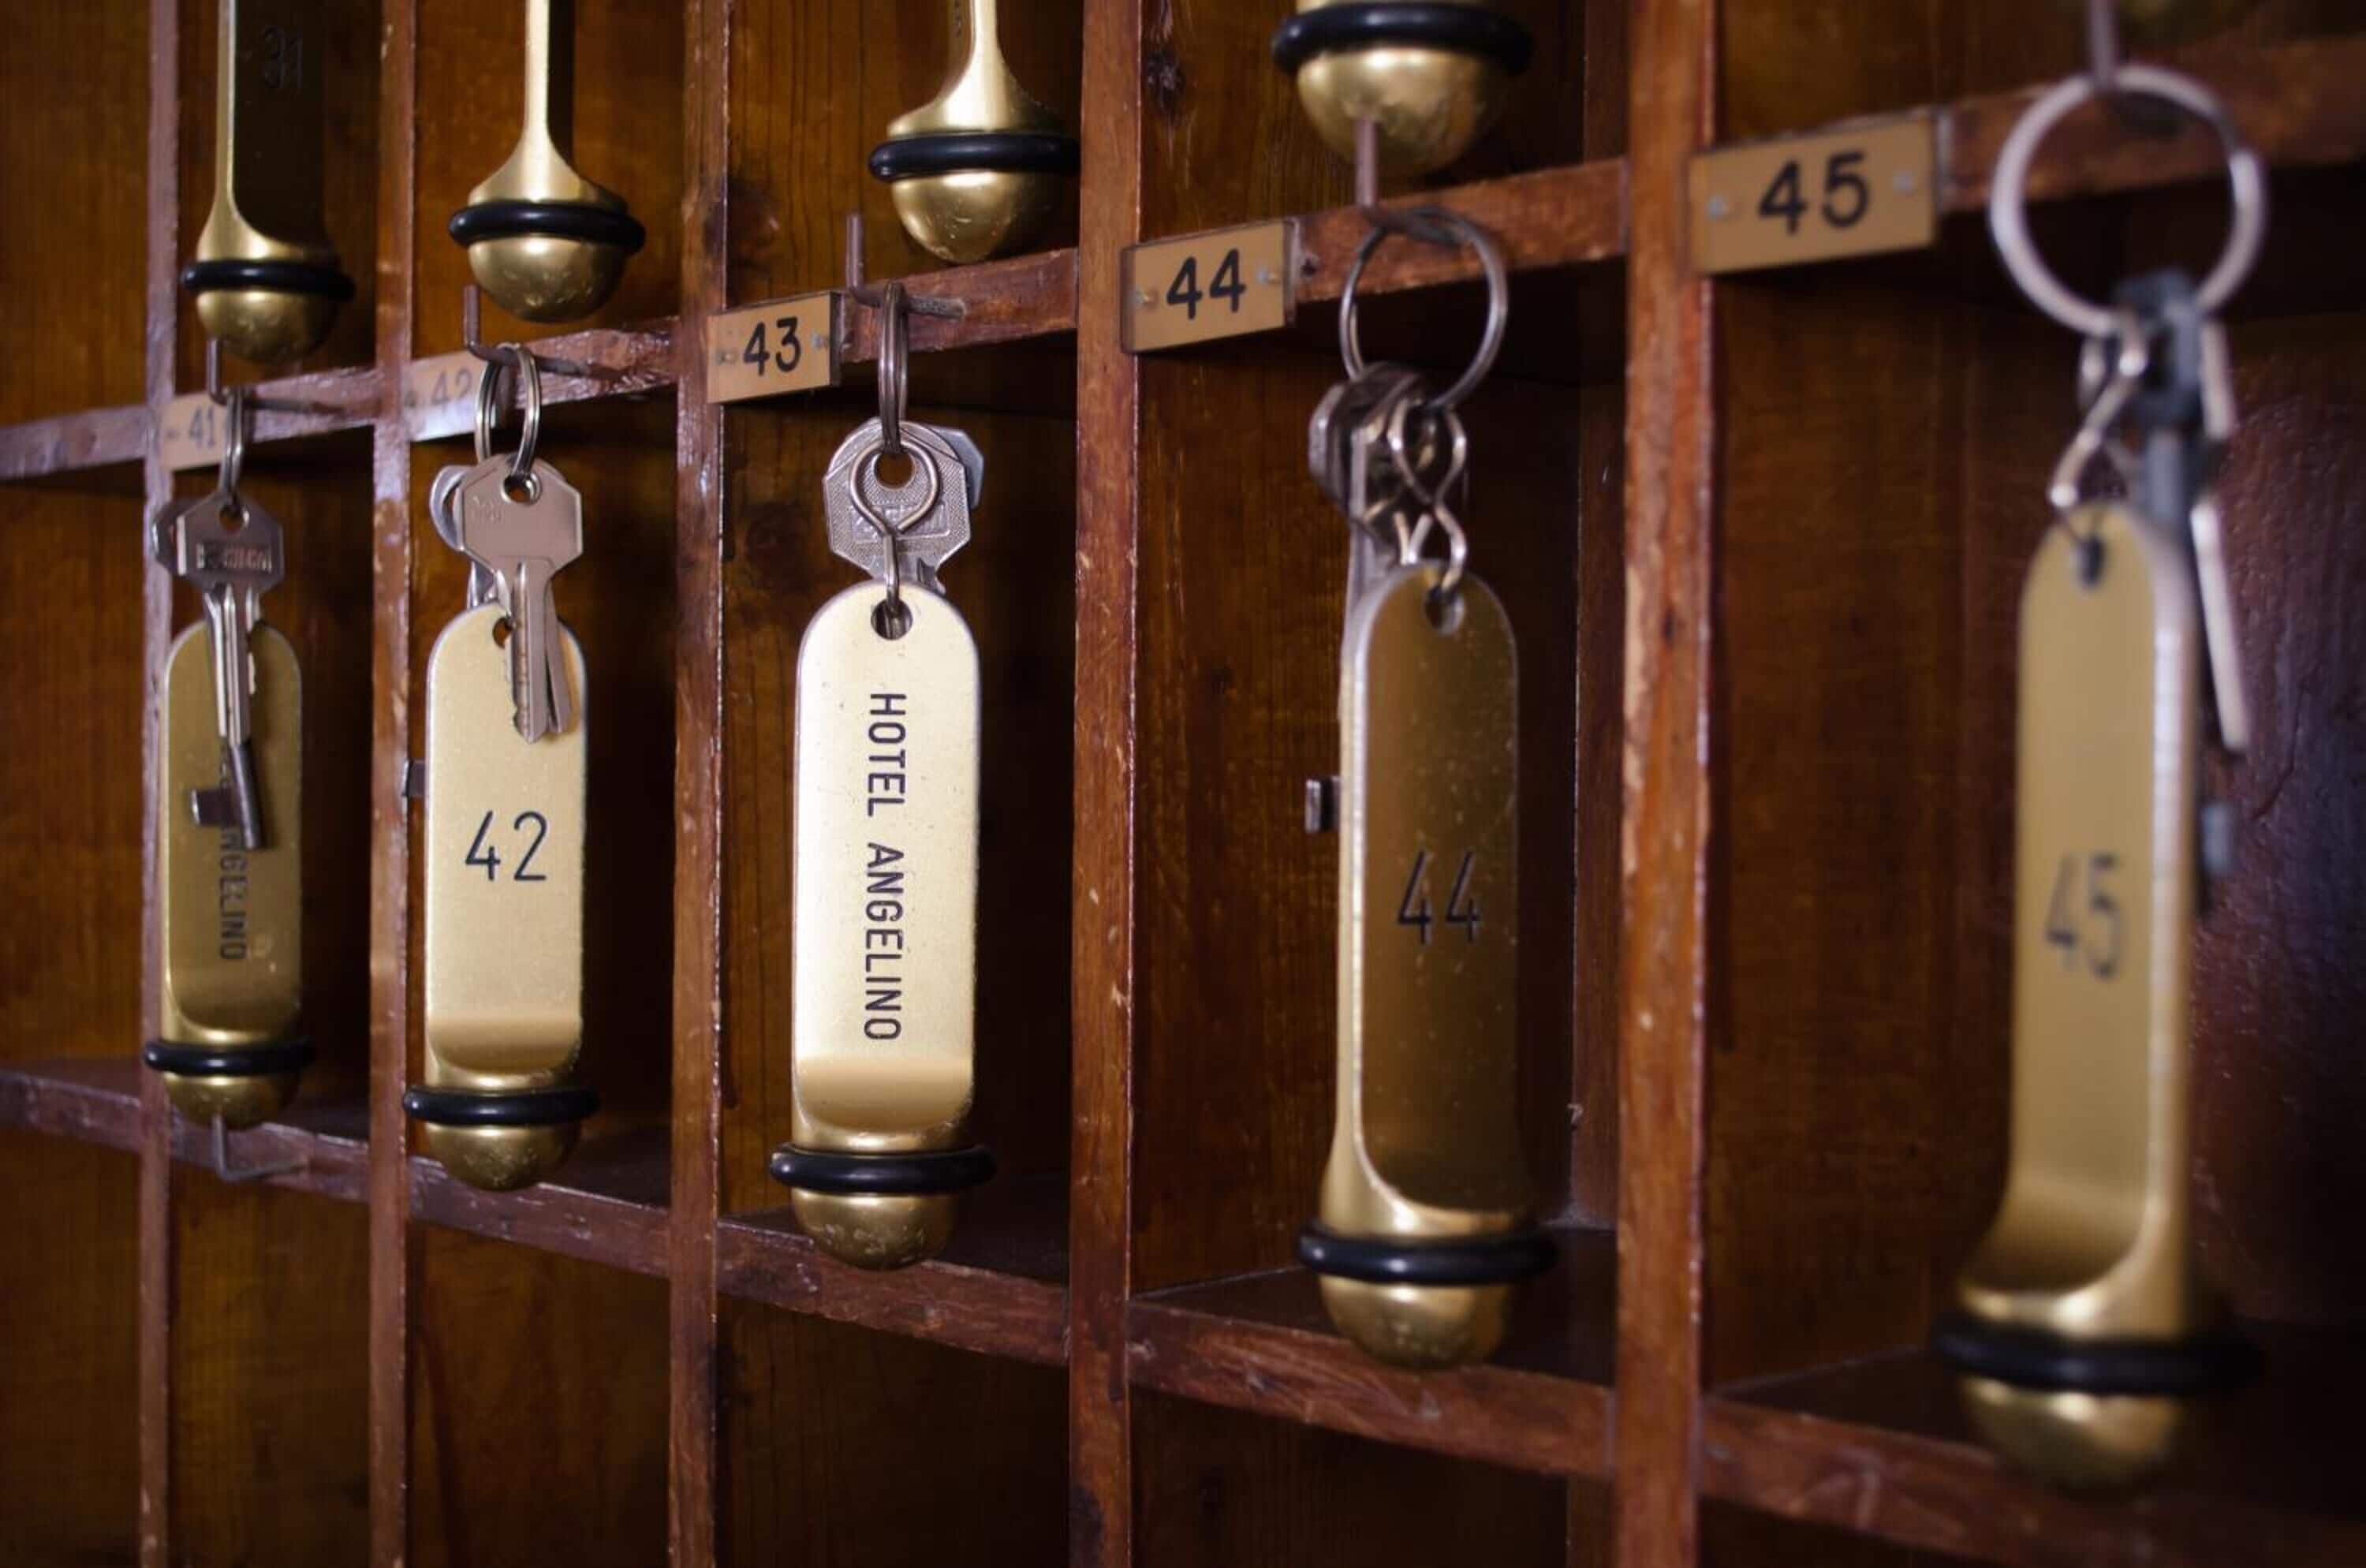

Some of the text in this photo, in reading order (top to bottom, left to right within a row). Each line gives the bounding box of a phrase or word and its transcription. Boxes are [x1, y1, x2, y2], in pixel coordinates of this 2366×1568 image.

[1758, 151, 1870, 235] 45
[1166, 248, 1247, 319] 44
[743, 316, 801, 376] 43
[431, 367, 473, 412] 42
[187, 404, 216, 453] 41
[465, 810, 547, 881] 42
[863, 693, 907, 1040] HOTEL ANGELINO
[219, 822, 248, 960] NGELINO
[1397, 849, 1481, 944] 44
[2045, 852, 2124, 981] 45
